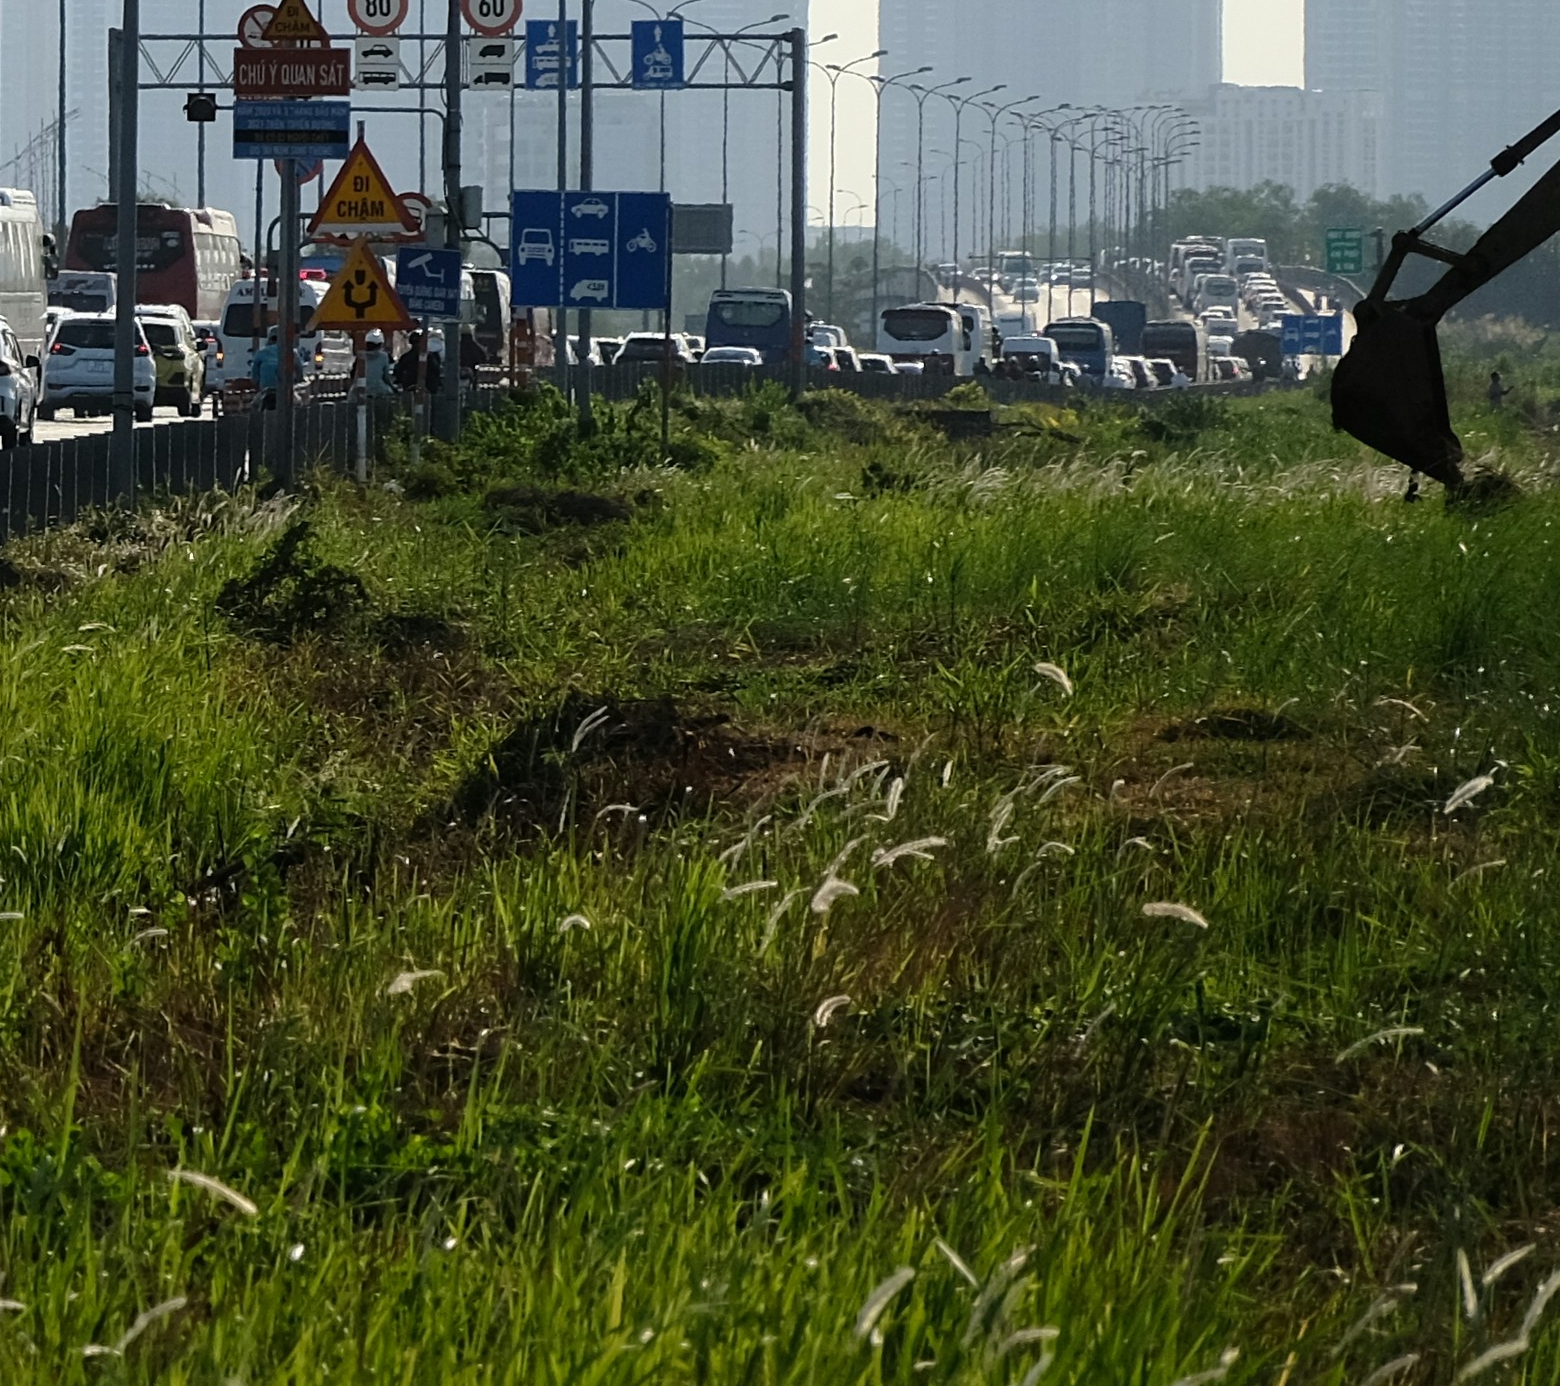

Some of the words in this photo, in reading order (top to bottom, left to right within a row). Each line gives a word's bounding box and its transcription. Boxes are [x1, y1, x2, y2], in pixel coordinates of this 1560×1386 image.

[287, 6, 299, 17] ĐI
[239, 60, 265, 85] CHÚ
[269, 60, 278, 85] Ý
[280, 63, 316, 86] QUAN
[319, 60, 345, 86] SÁT
[353, 175, 370, 192] ĐI
[336, 197, 385, 221] CHẬM
